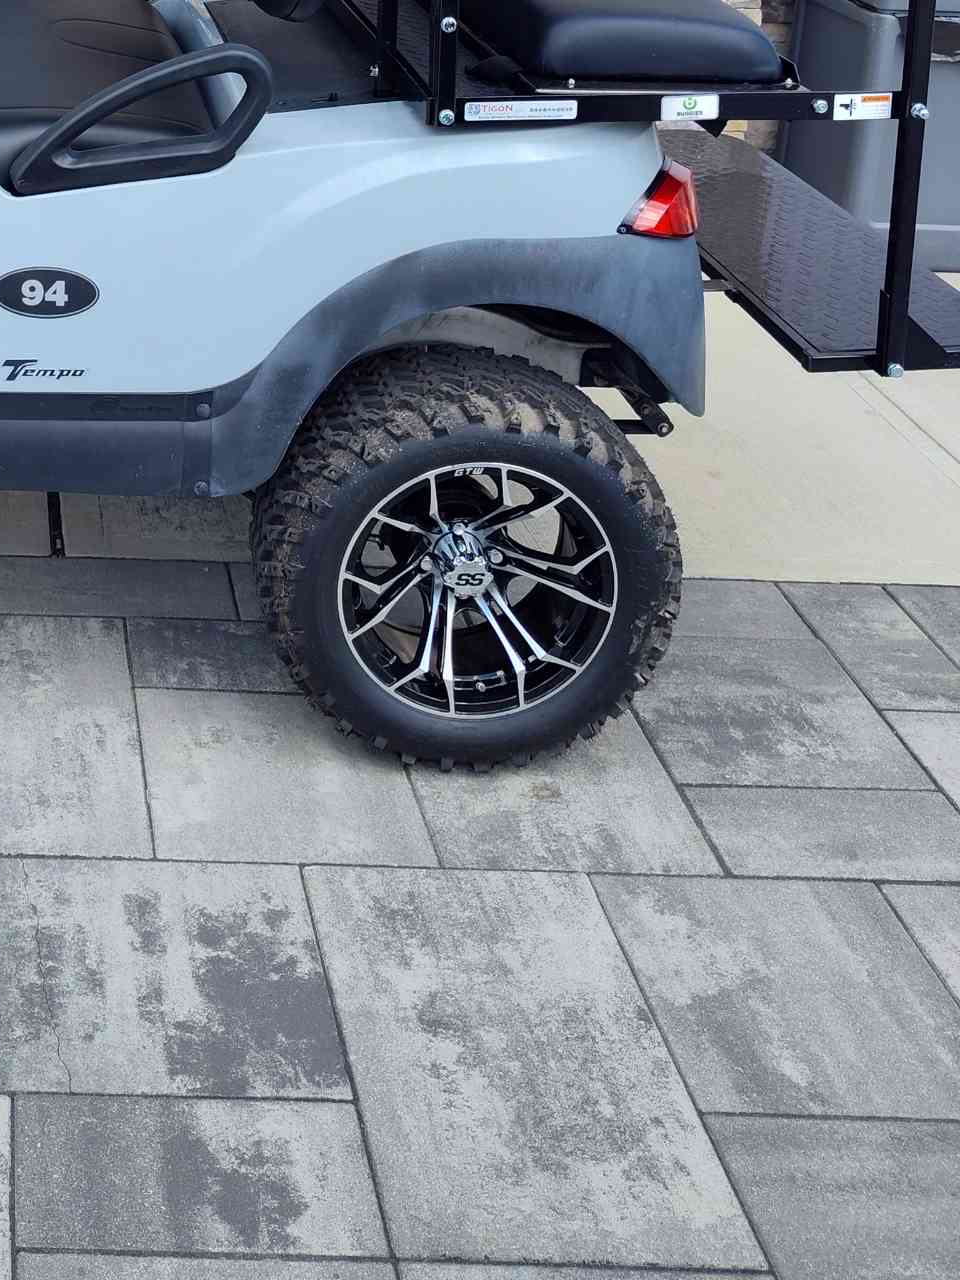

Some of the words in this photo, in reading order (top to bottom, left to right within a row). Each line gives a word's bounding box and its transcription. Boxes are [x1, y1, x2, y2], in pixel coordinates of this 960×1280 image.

[20, 279, 69, 307] 94
[1, 359, 86, 382] Tempo
[453, 467, 485, 478] GTW
[454, 572, 486, 587] SS
